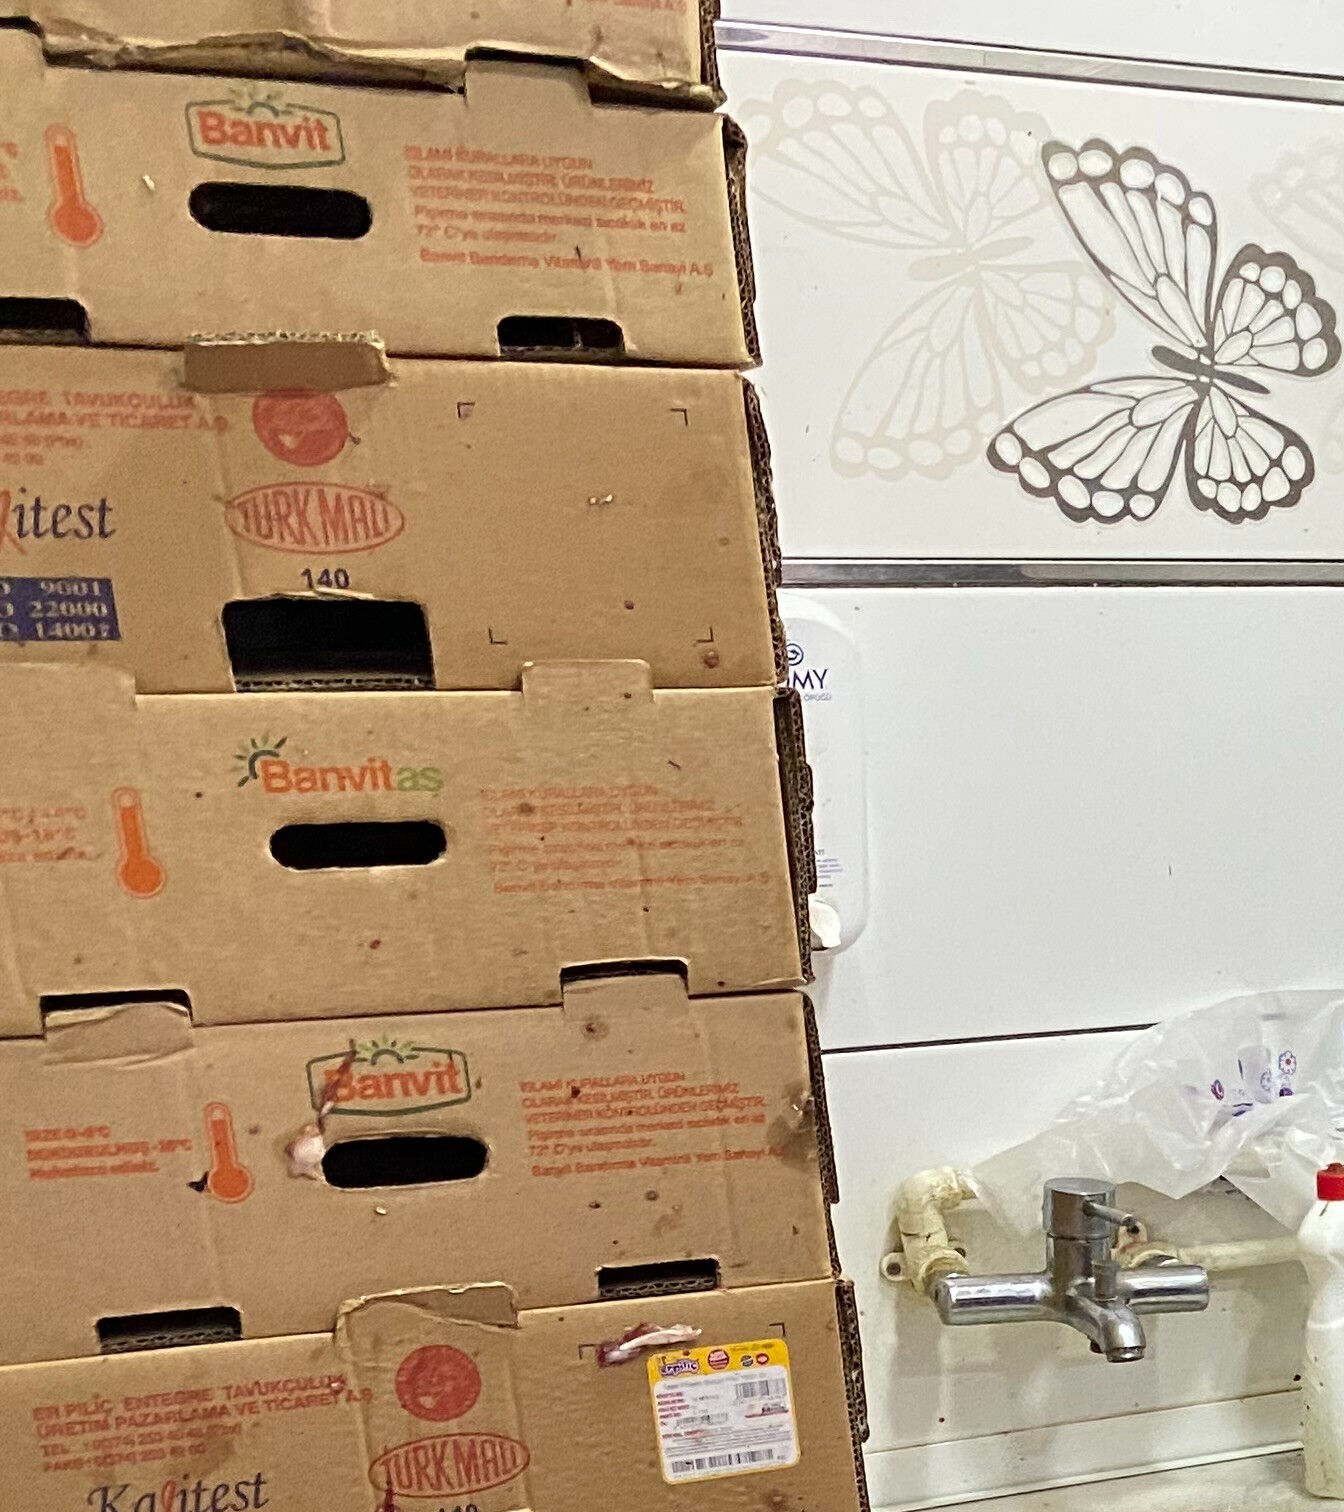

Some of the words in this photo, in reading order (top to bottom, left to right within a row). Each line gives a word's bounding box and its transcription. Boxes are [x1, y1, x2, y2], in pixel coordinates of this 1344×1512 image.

[197, 109, 331, 153] Banvit
[301, 568, 349, 588] 140
[787, 668, 828, 689] MY
